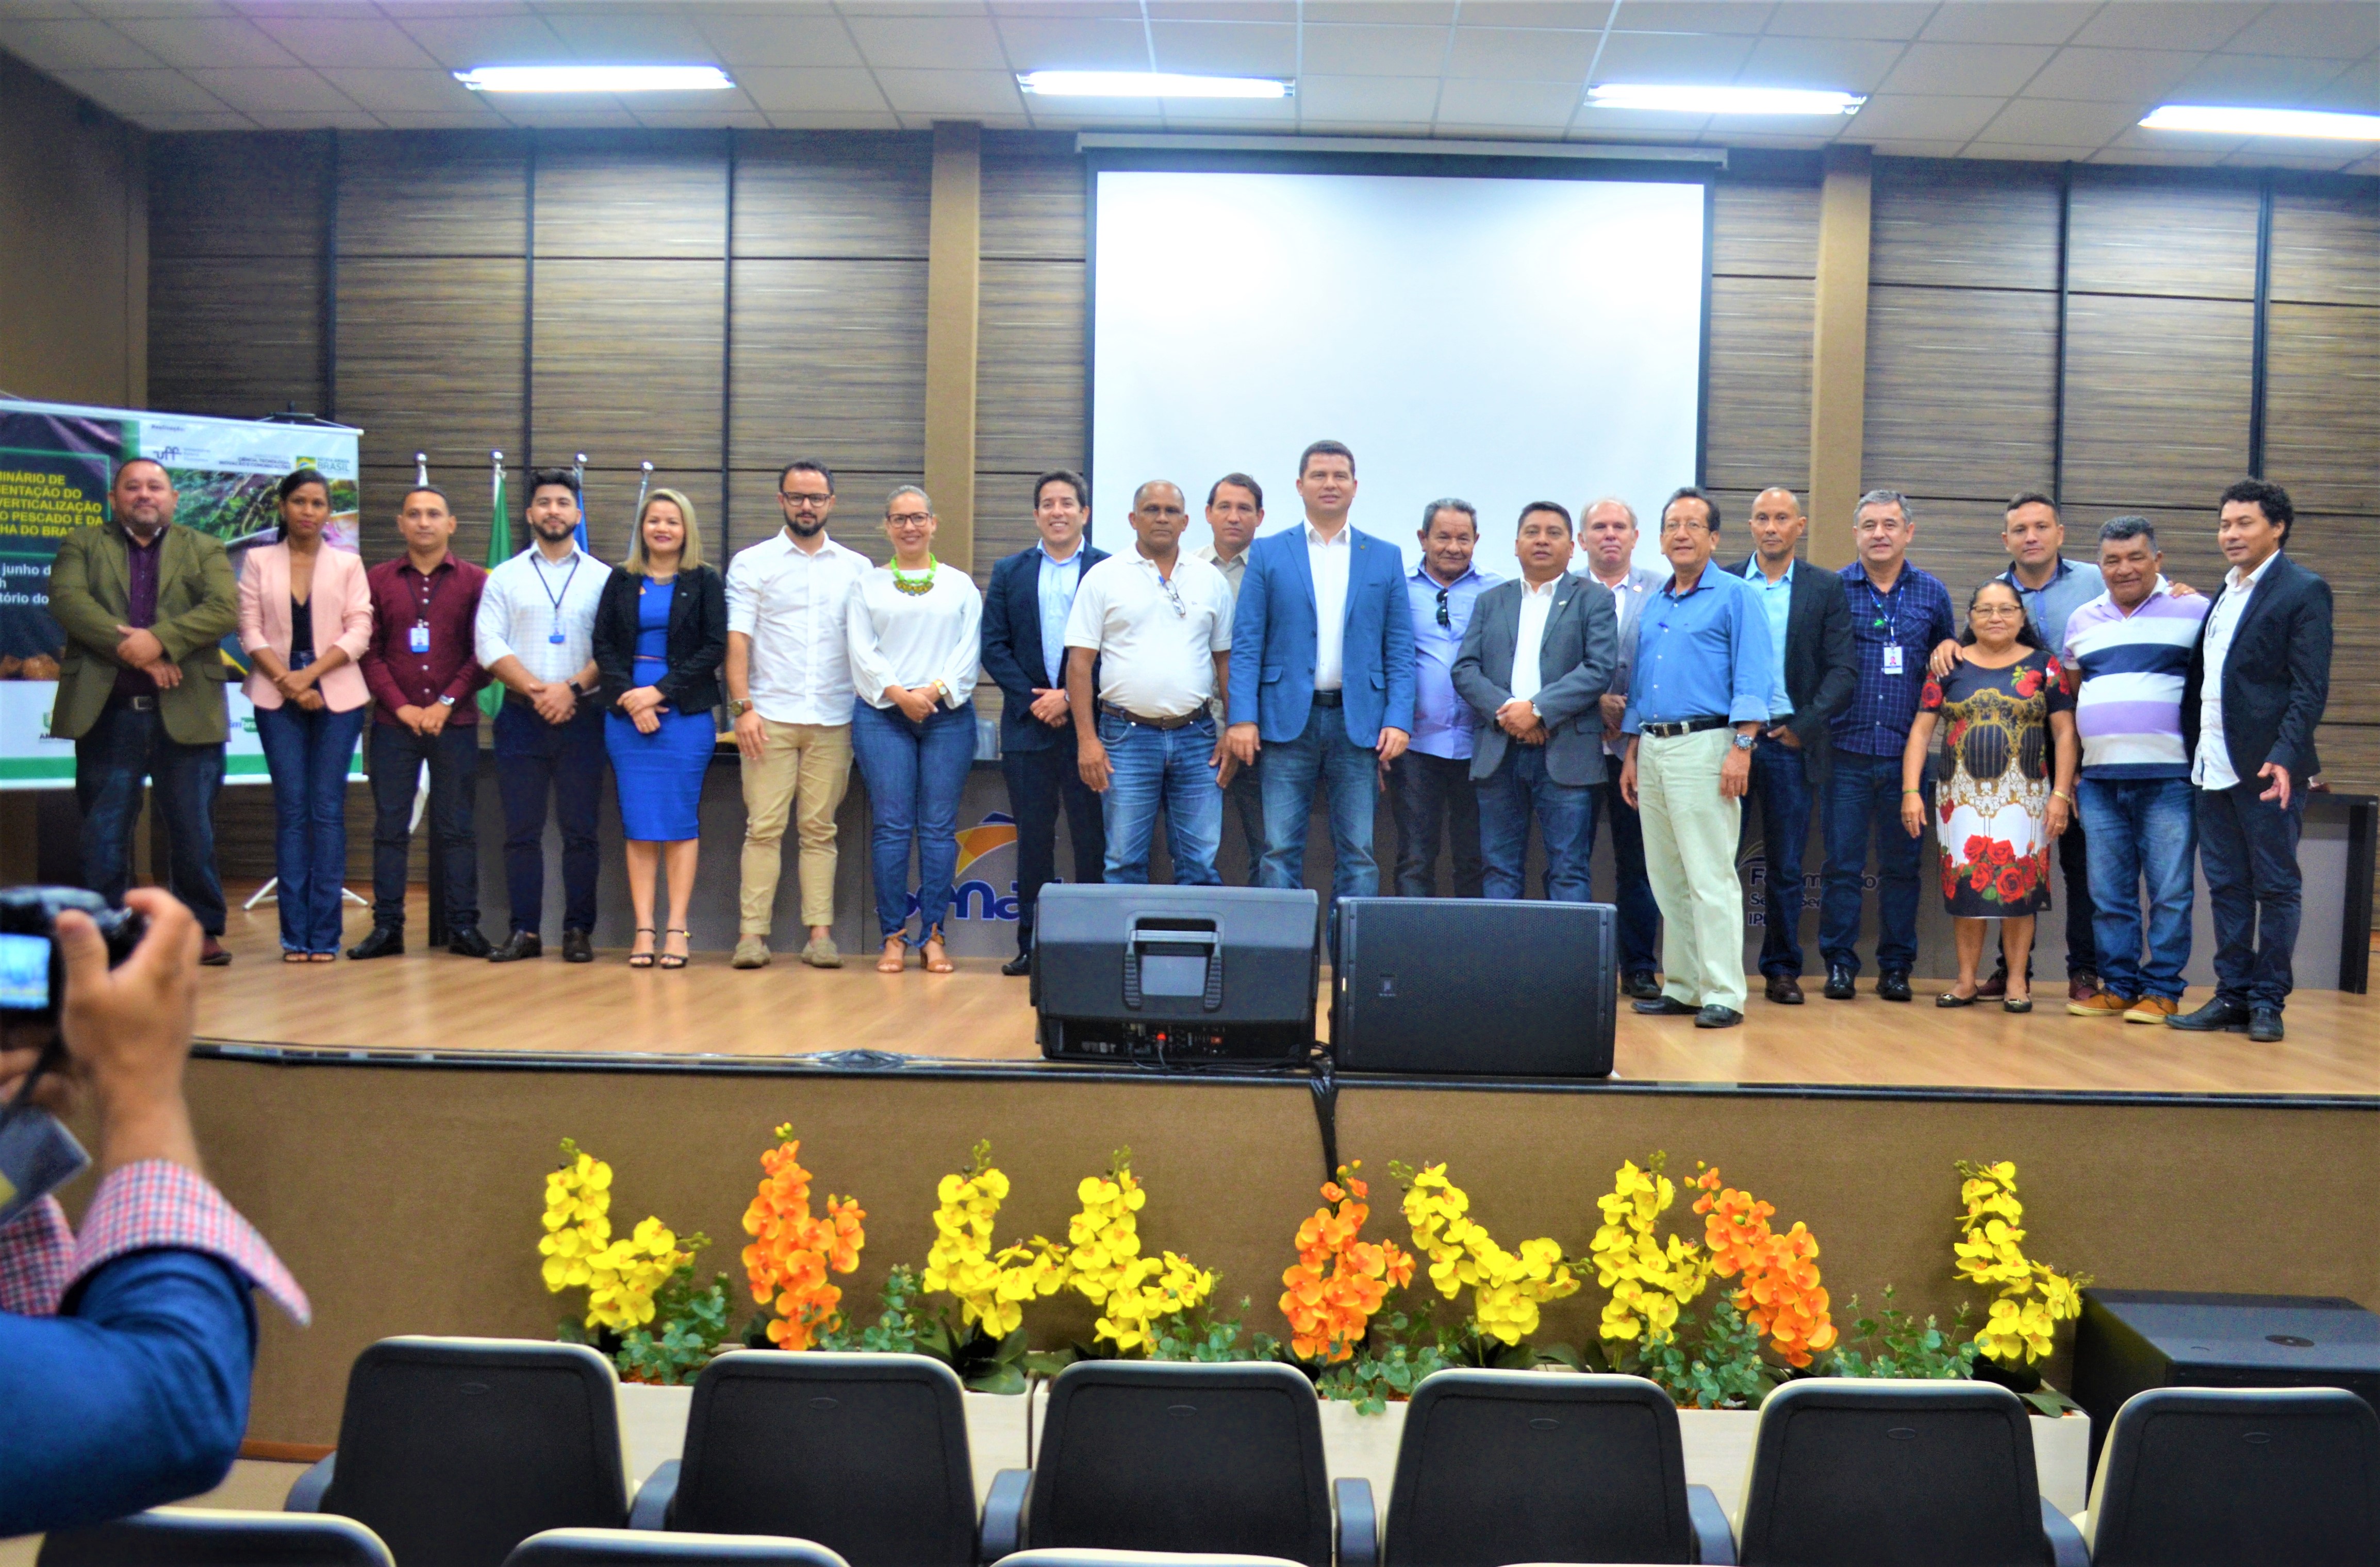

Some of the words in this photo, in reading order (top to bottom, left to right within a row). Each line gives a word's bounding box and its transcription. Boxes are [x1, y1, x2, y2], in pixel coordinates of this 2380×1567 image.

[154, 446, 181, 461] uff
[318, 462, 350, 472] BRASIL
[0, 470, 45, 484] INÁRIO
[49, 474, 65, 485] DE
[63, 488, 82, 499] DO
[12, 511, 72, 525] PESCADO
[75, 514, 82, 525] E
[86, 515, 103, 526] DA
[21, 524, 39, 537] DO
[2, 562, 39, 576] junho
[32, 593, 49, 605] do
